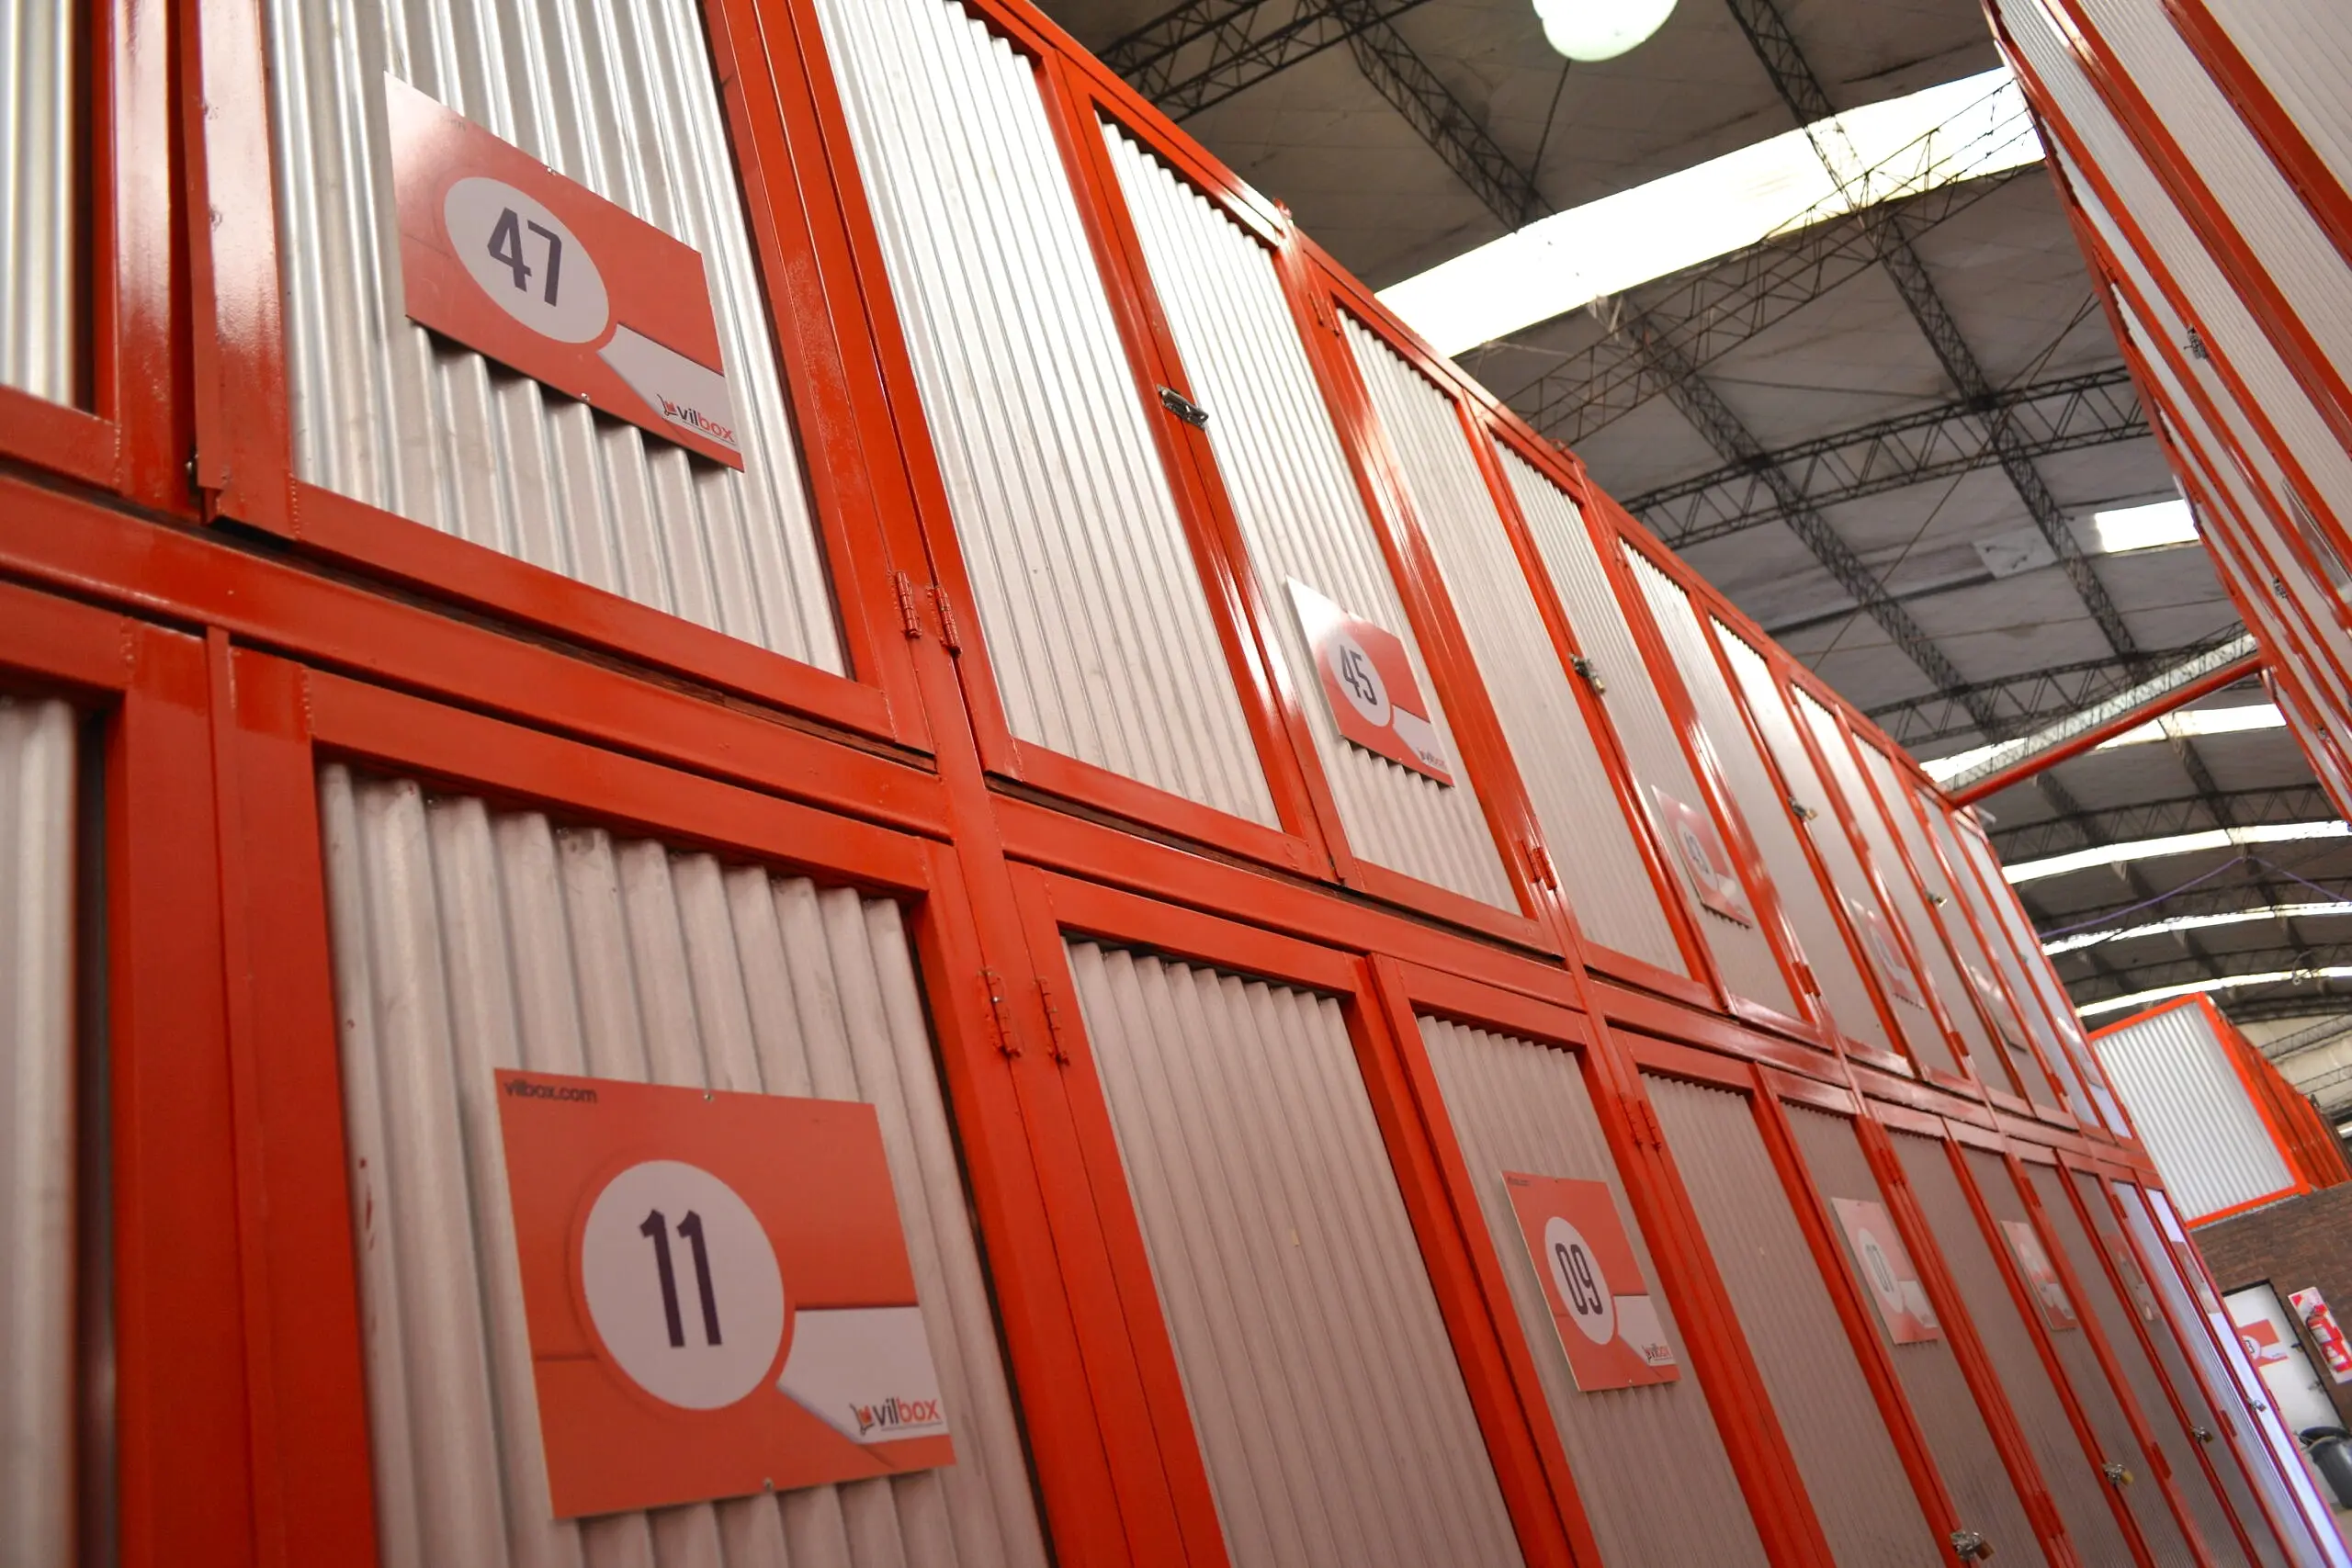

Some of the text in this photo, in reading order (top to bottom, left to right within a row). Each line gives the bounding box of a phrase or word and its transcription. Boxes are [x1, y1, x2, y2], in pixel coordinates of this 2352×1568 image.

[487, 206, 563, 307] 47
[676, 405, 735, 443] vilbox
[1340, 645, 1377, 705] 45
[503, 1078, 598, 1104] vilbox.com
[639, 1209, 722, 1348] 11
[1555, 1243, 1603, 1315] 09
[872, 1396, 941, 1427] vilbox
